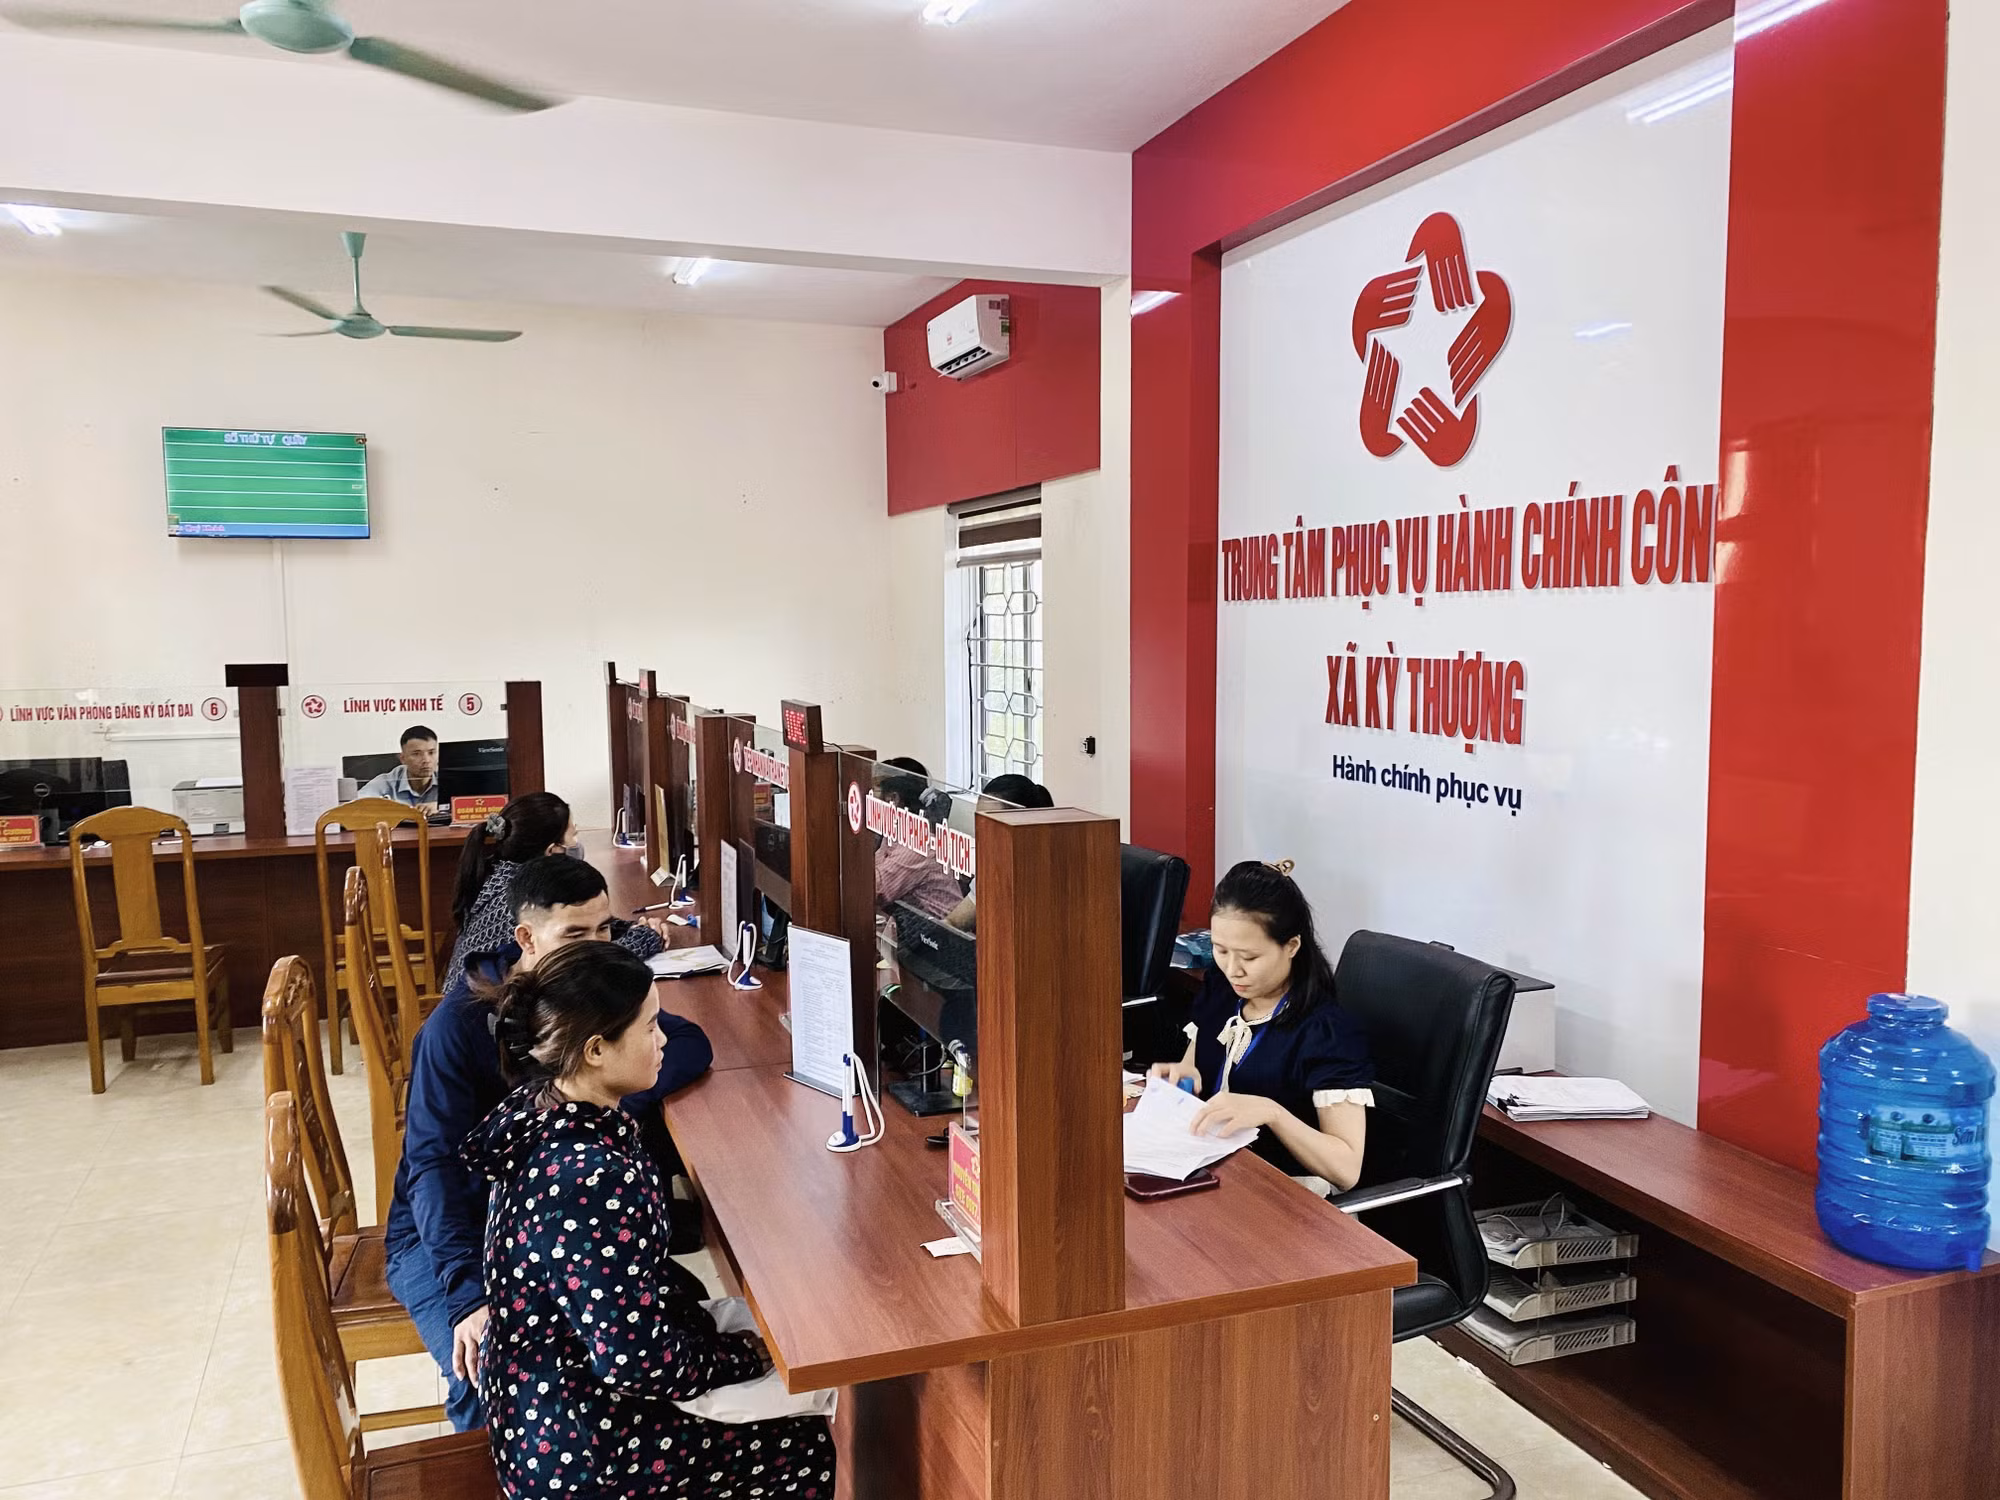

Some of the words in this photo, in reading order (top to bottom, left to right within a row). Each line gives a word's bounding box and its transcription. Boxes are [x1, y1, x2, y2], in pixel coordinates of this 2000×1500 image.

[1222, 533, 1279, 601] TRUNG
[1283, 515, 1326, 599] TÂM
[1331, 519, 1390, 610] PHỤC
[1395, 516, 1429, 607] VỤ
[1435, 493, 1514, 592] HÀNH
[1521, 481, 1624, 590] CHÍNH
[1631, 465, 1718, 585] CÔN
[10, 704, 33, 722] LĨNH
[36, 704, 55, 725] VỰC
[57, 703, 77, 720] VĂN
[80, 702, 113, 720] PHÒNG
[114, 702, 142, 719] ĐĂNG
[158, 698, 176, 718] ĐẤT
[343, 697, 370, 713] LĨNH
[373, 697, 396, 715] VỰC
[400, 698, 427, 712] KINH
[430, 694, 445, 711] TẾ
[466, 697, 475, 711] 5
[1325, 641, 1359, 728] XÃ
[1365, 641, 1400, 730] KỲ
[1406, 650, 1525, 754] THƯỢNG
[1332, 754, 1377, 785] Hành
[1381, 763, 1431, 795] chính
[1436, 772, 1489, 809] phục
[1493, 785, 1522, 817] vụ
[866, 788, 883, 836] LĨNH
[882, 801, 898, 847] VỰC
[907, 809, 931, 858] PHÁP
[935, 818, 949, 875] HỘ
[949, 828, 973, 880] TỊCH
